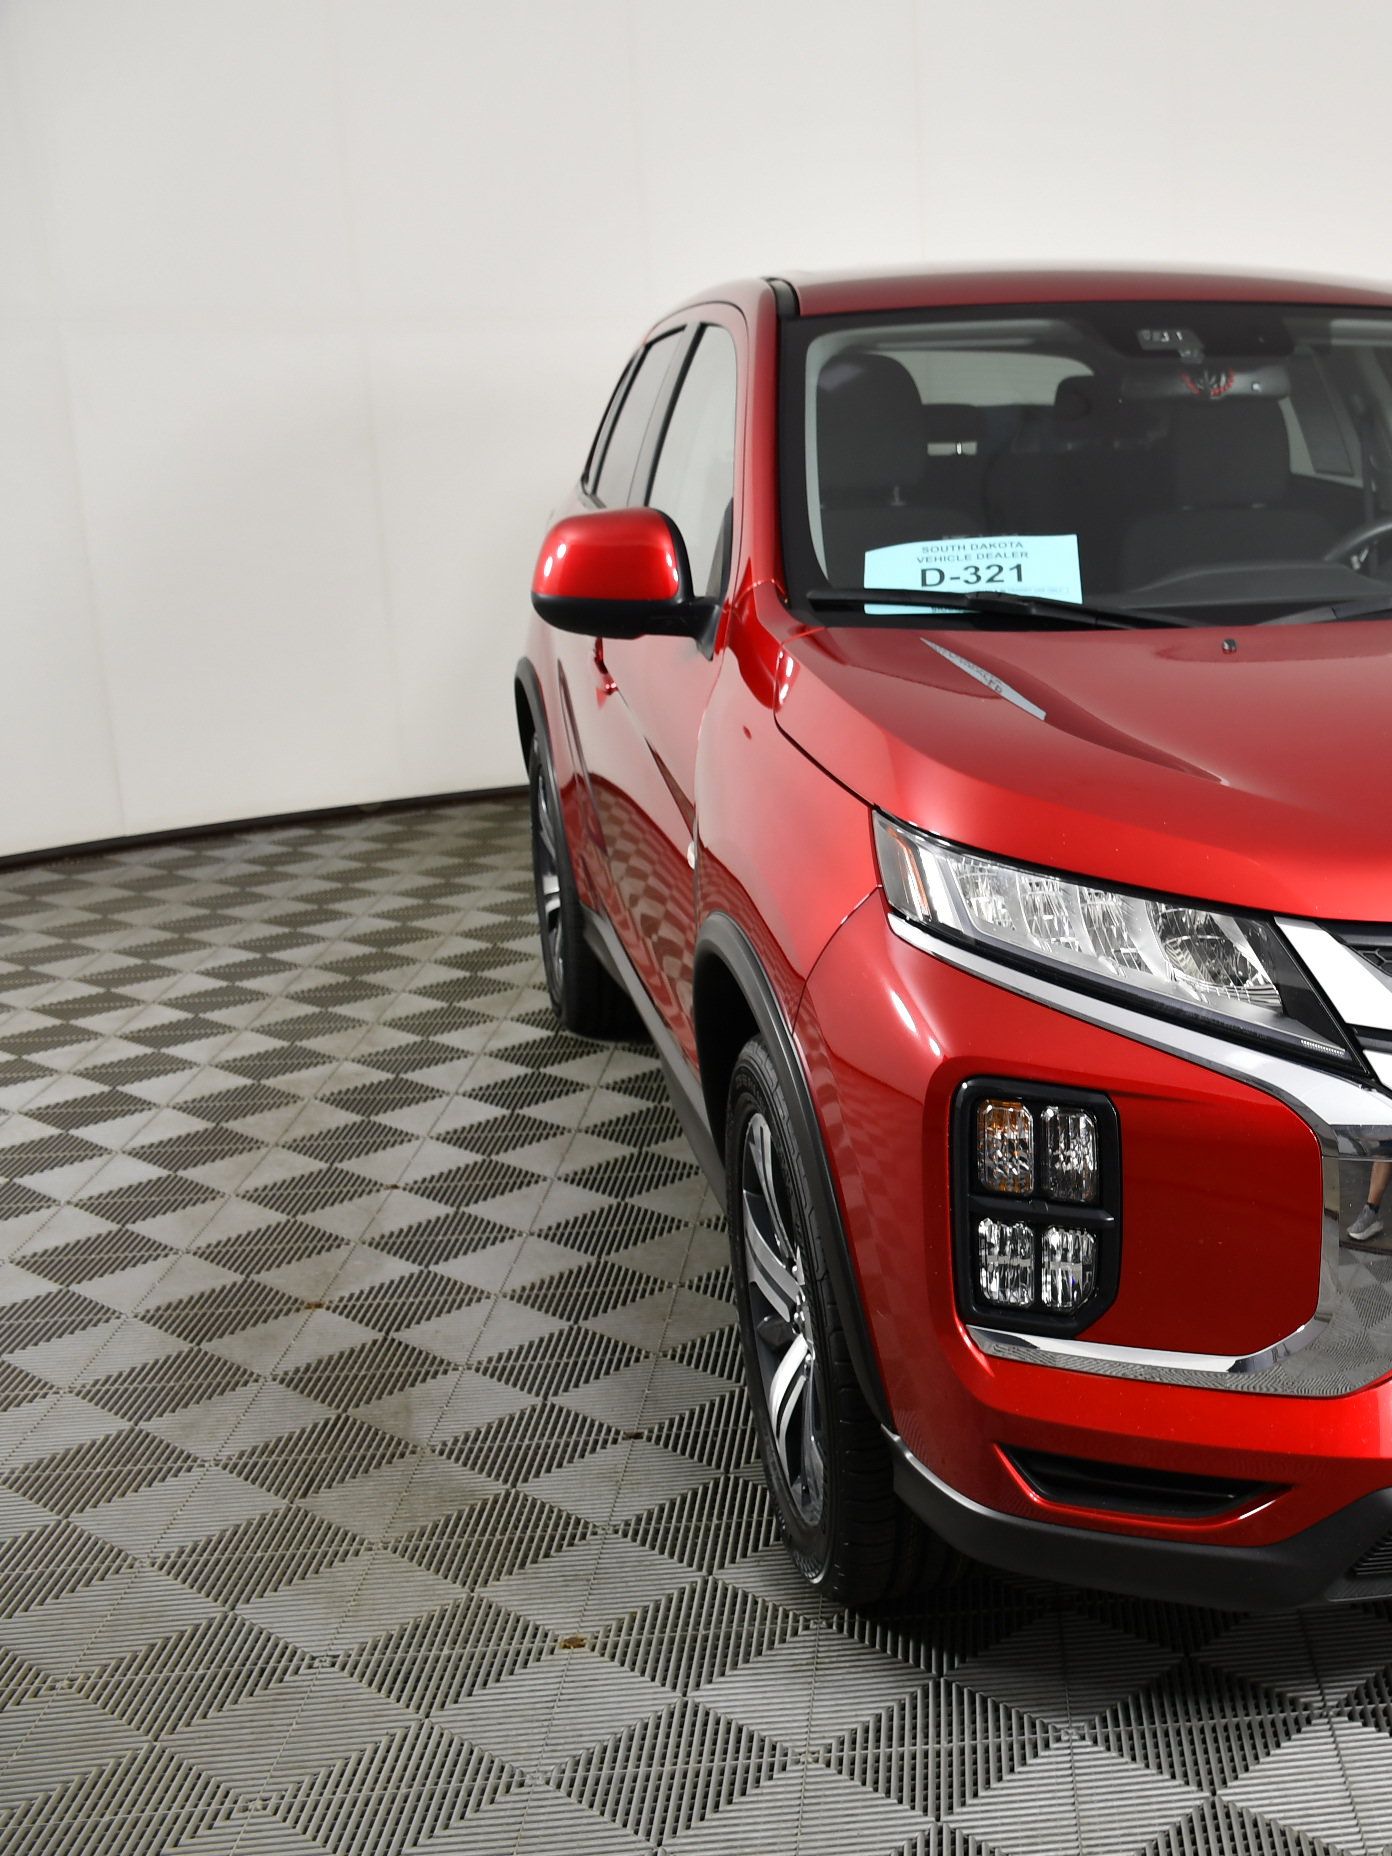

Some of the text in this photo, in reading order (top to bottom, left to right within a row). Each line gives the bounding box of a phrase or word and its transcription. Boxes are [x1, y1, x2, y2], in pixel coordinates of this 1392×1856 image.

[922, 541, 1023, 554] SOUTH DAKOTA
[916, 550, 1028, 564] VEHICLE DEALER
[920, 563, 1023, 587] D-321
